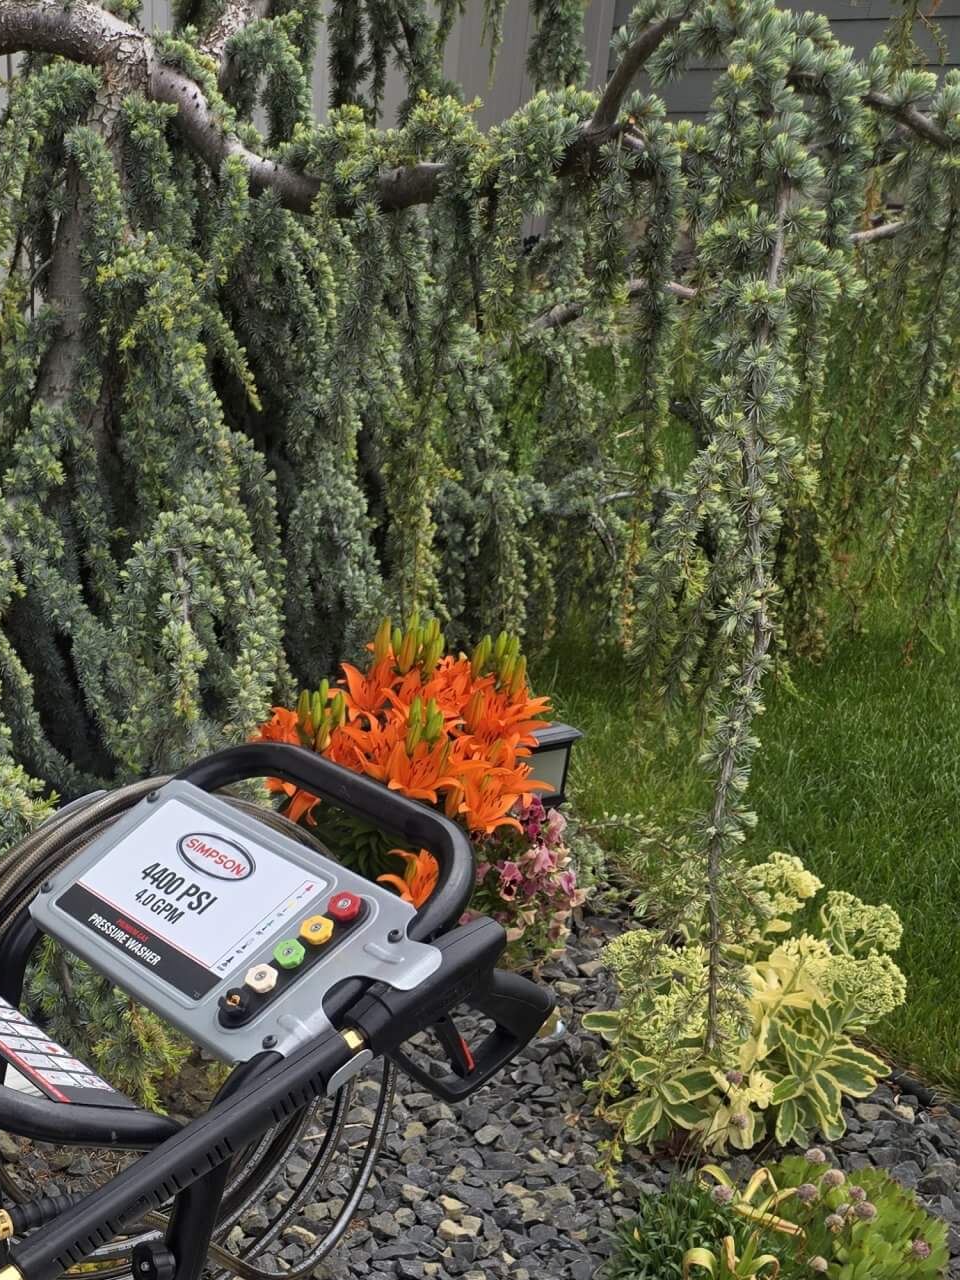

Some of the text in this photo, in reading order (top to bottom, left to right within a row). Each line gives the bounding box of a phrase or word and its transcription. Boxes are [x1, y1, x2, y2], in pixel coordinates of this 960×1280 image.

[185, 838, 246, 876] SIMPSON
[135, 888, 185, 924] 4.0 GPM
[141, 862, 218, 915] 4400 PSI
[88, 913, 128, 944] PRESSURE
[125, 937, 162, 966] WASHER
